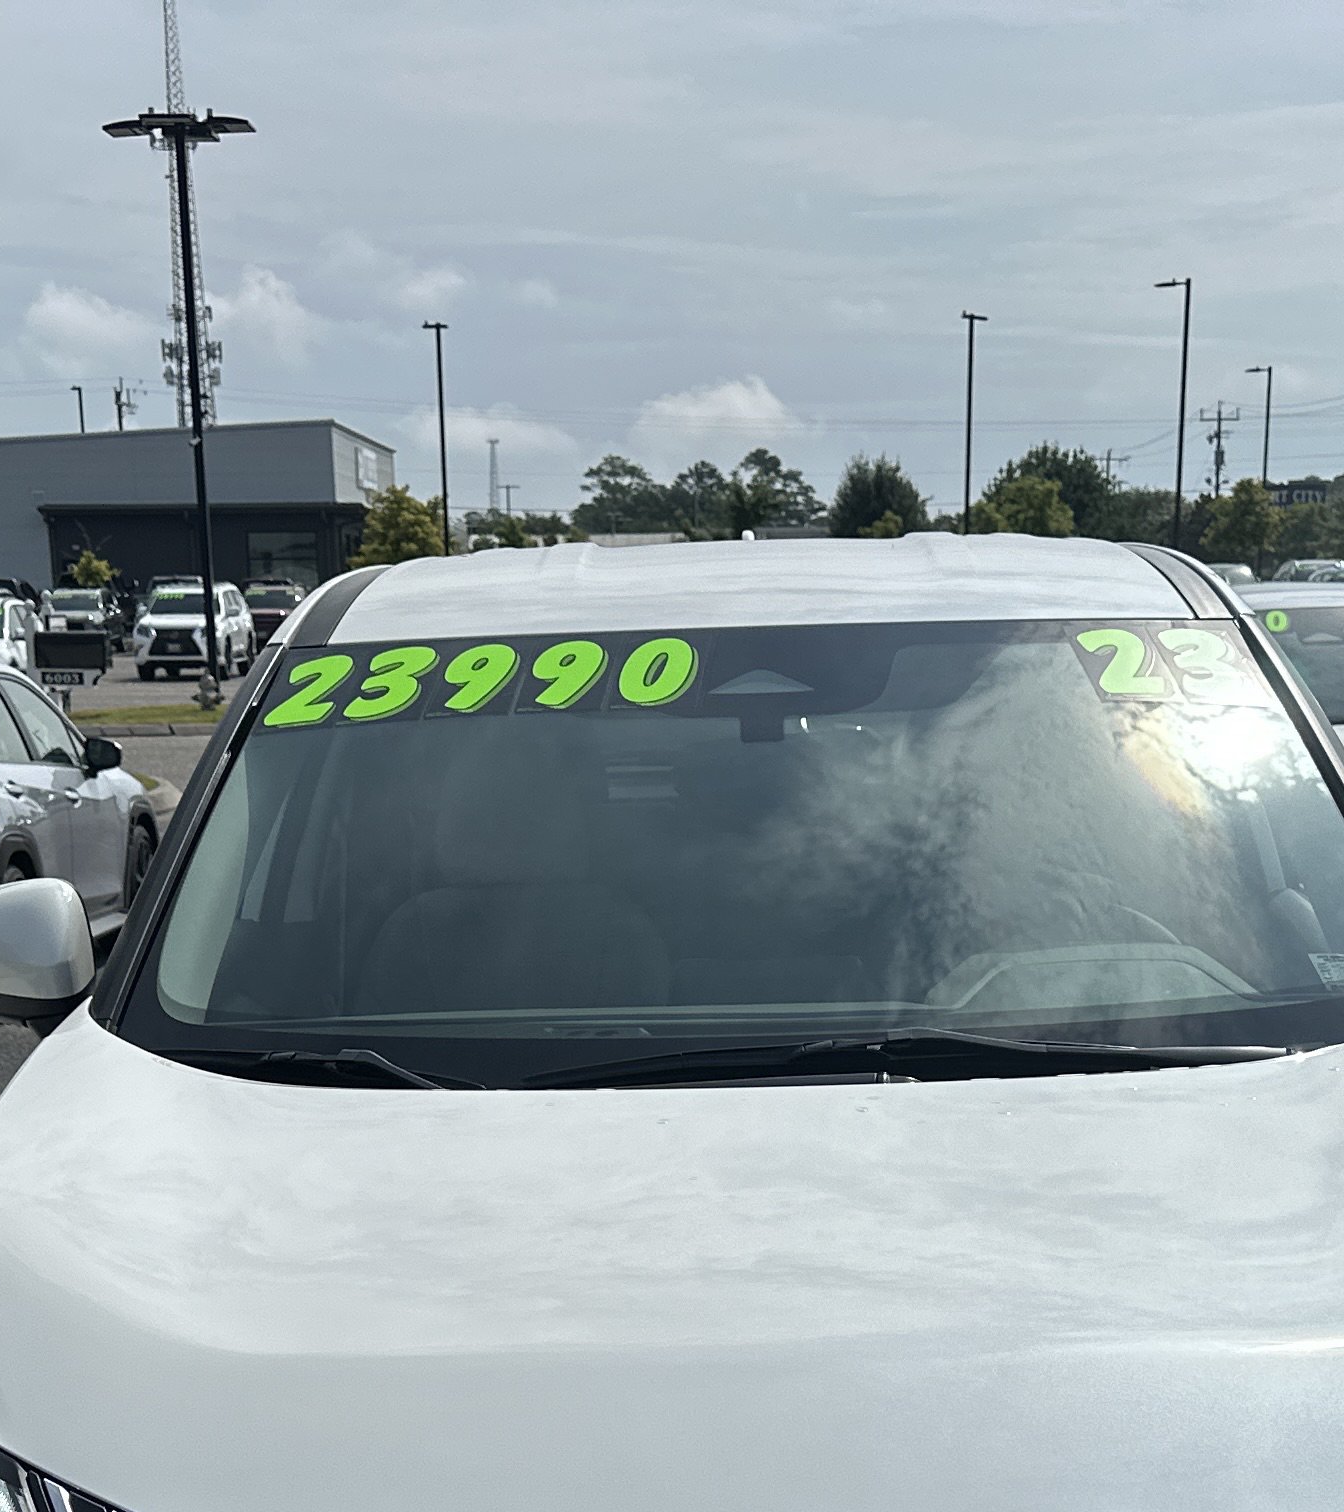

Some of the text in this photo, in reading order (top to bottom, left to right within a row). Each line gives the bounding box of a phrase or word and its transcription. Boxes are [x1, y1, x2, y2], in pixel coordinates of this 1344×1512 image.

[44, 673, 80, 684] 6003
[263, 628, 1244, 728] 23990 23
